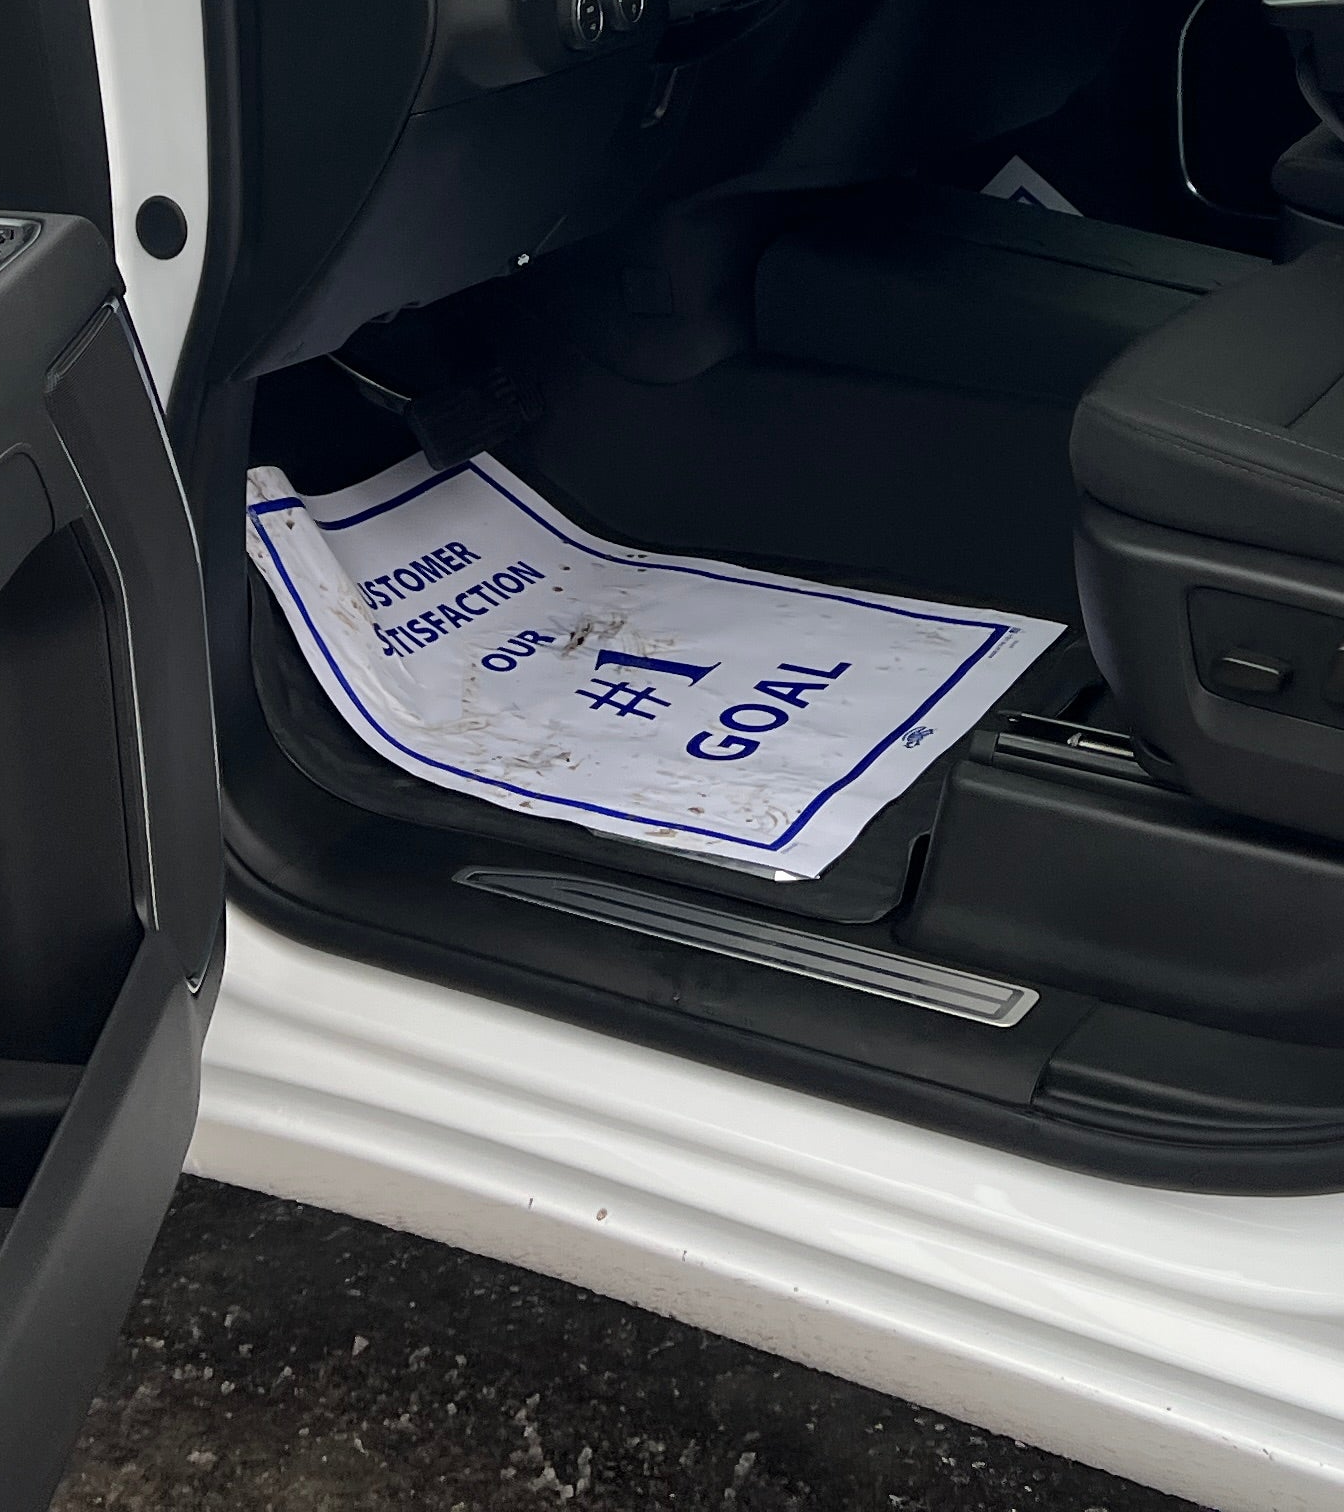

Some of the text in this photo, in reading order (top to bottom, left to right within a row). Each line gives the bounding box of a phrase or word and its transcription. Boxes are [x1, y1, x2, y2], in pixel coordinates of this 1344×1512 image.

[356, 541, 482, 610] USTOMER
[373, 560, 546, 658] STISFACTION
[481, 630, 557, 672] OUR
[575, 649, 722, 721] #1
[686, 662, 853, 761] GOAL
